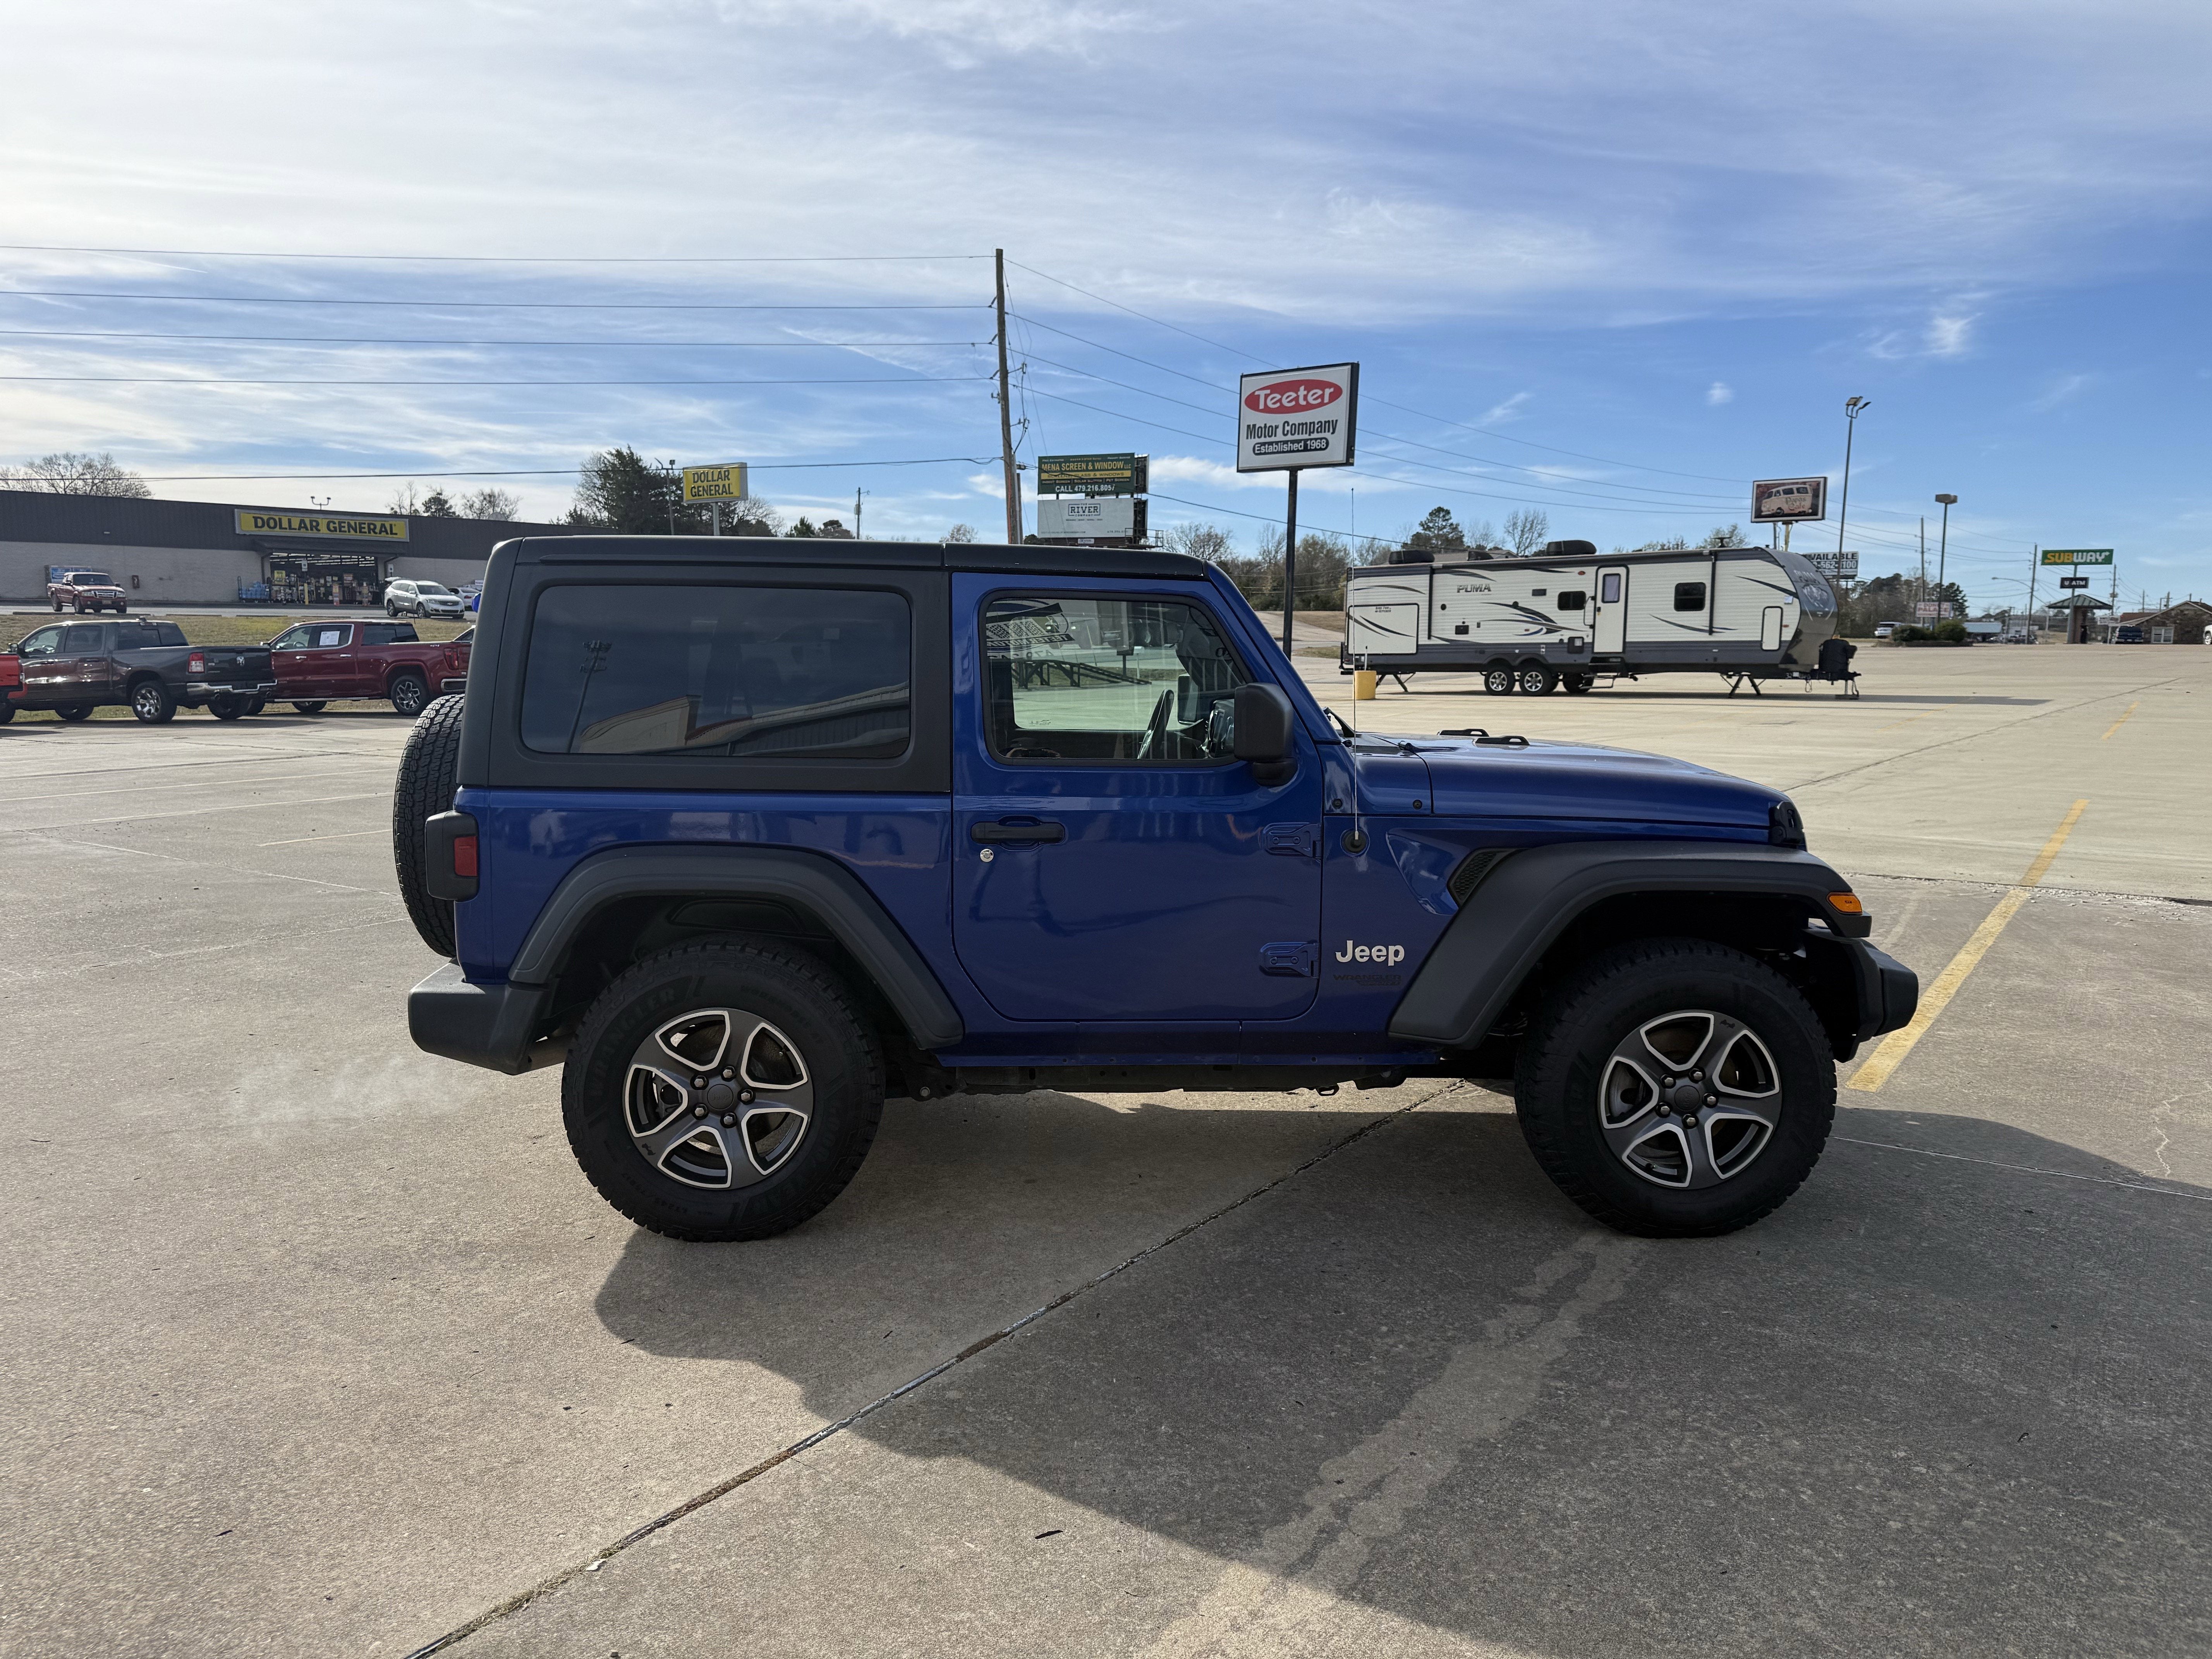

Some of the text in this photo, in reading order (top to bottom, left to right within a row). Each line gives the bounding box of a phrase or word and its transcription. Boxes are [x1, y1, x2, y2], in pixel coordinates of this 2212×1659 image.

[1254, 385, 1334, 410] Teeter
[1245, 419, 1338, 440] Motor Company
[1254, 439, 1327, 453] Established 1968
[1042, 463, 1060, 471] MENA
[1094, 461, 1124, 470] WINDOW
[692, 469, 730, 483] DOLLAR
[690, 483, 733, 497] GENERAL
[252, 515, 398, 536] DOLLAR GENERAL
[2044, 551, 2110, 563] SUBWAY
[1456, 584, 1492, 593] PUMA
[1335, 940, 1405, 966] Jeep
